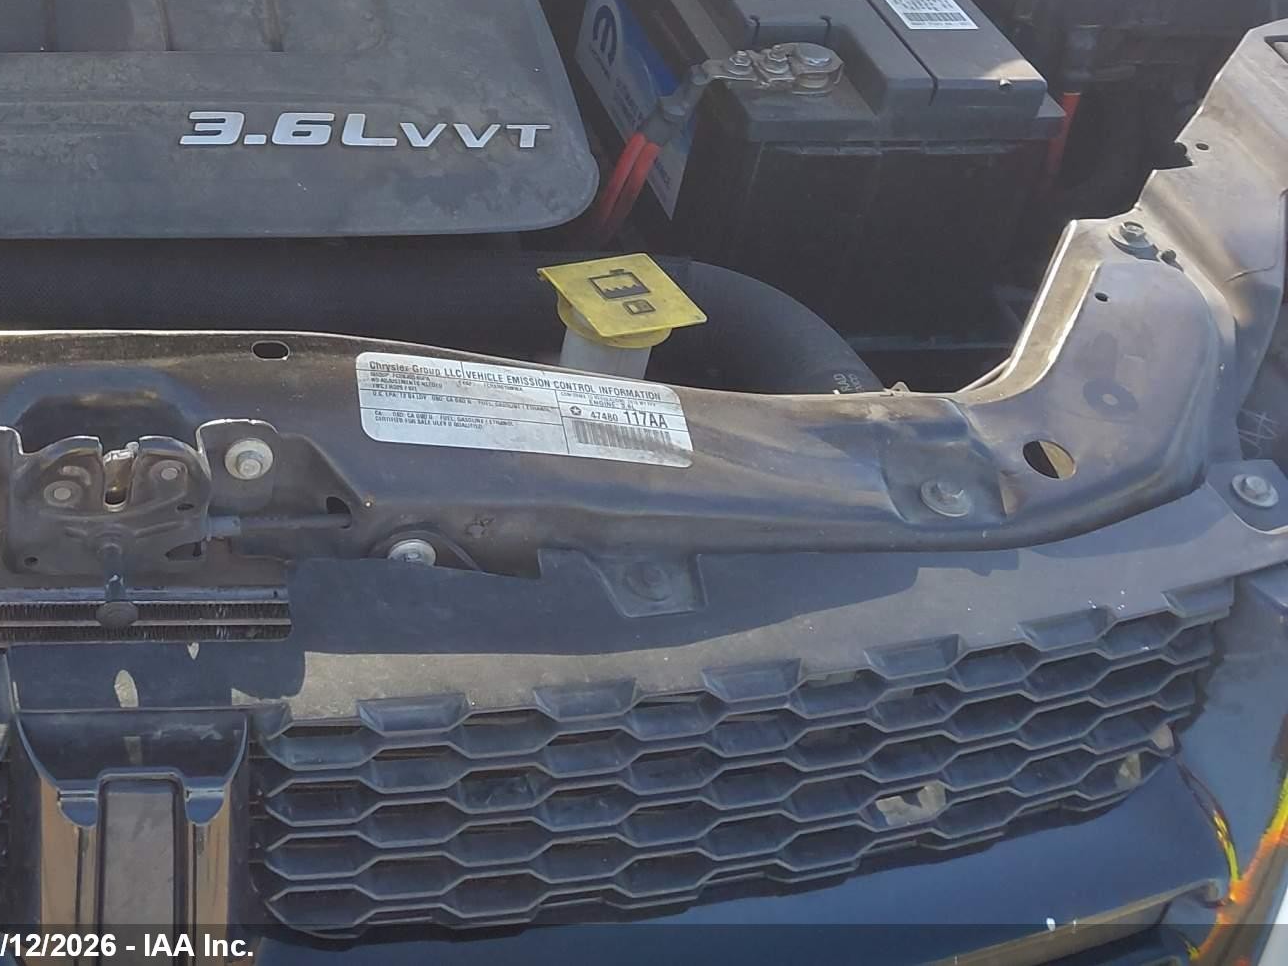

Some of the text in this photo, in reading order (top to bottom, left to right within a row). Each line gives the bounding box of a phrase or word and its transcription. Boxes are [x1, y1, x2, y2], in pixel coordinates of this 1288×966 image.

[179, 111, 551, 148] 3.6L VVT
[369, 361, 409, 373] Chrysler
[412, 364, 441, 377] Group
[444, 367, 462, 378] LLC
[465, 370, 504, 383] VEHICLE
[506, 375, 551, 388] EMISSION
[553, 380, 596, 393] CONTROL
[598, 386, 662, 401] INFORMATION
[624, 411, 669, 429] 117AA
